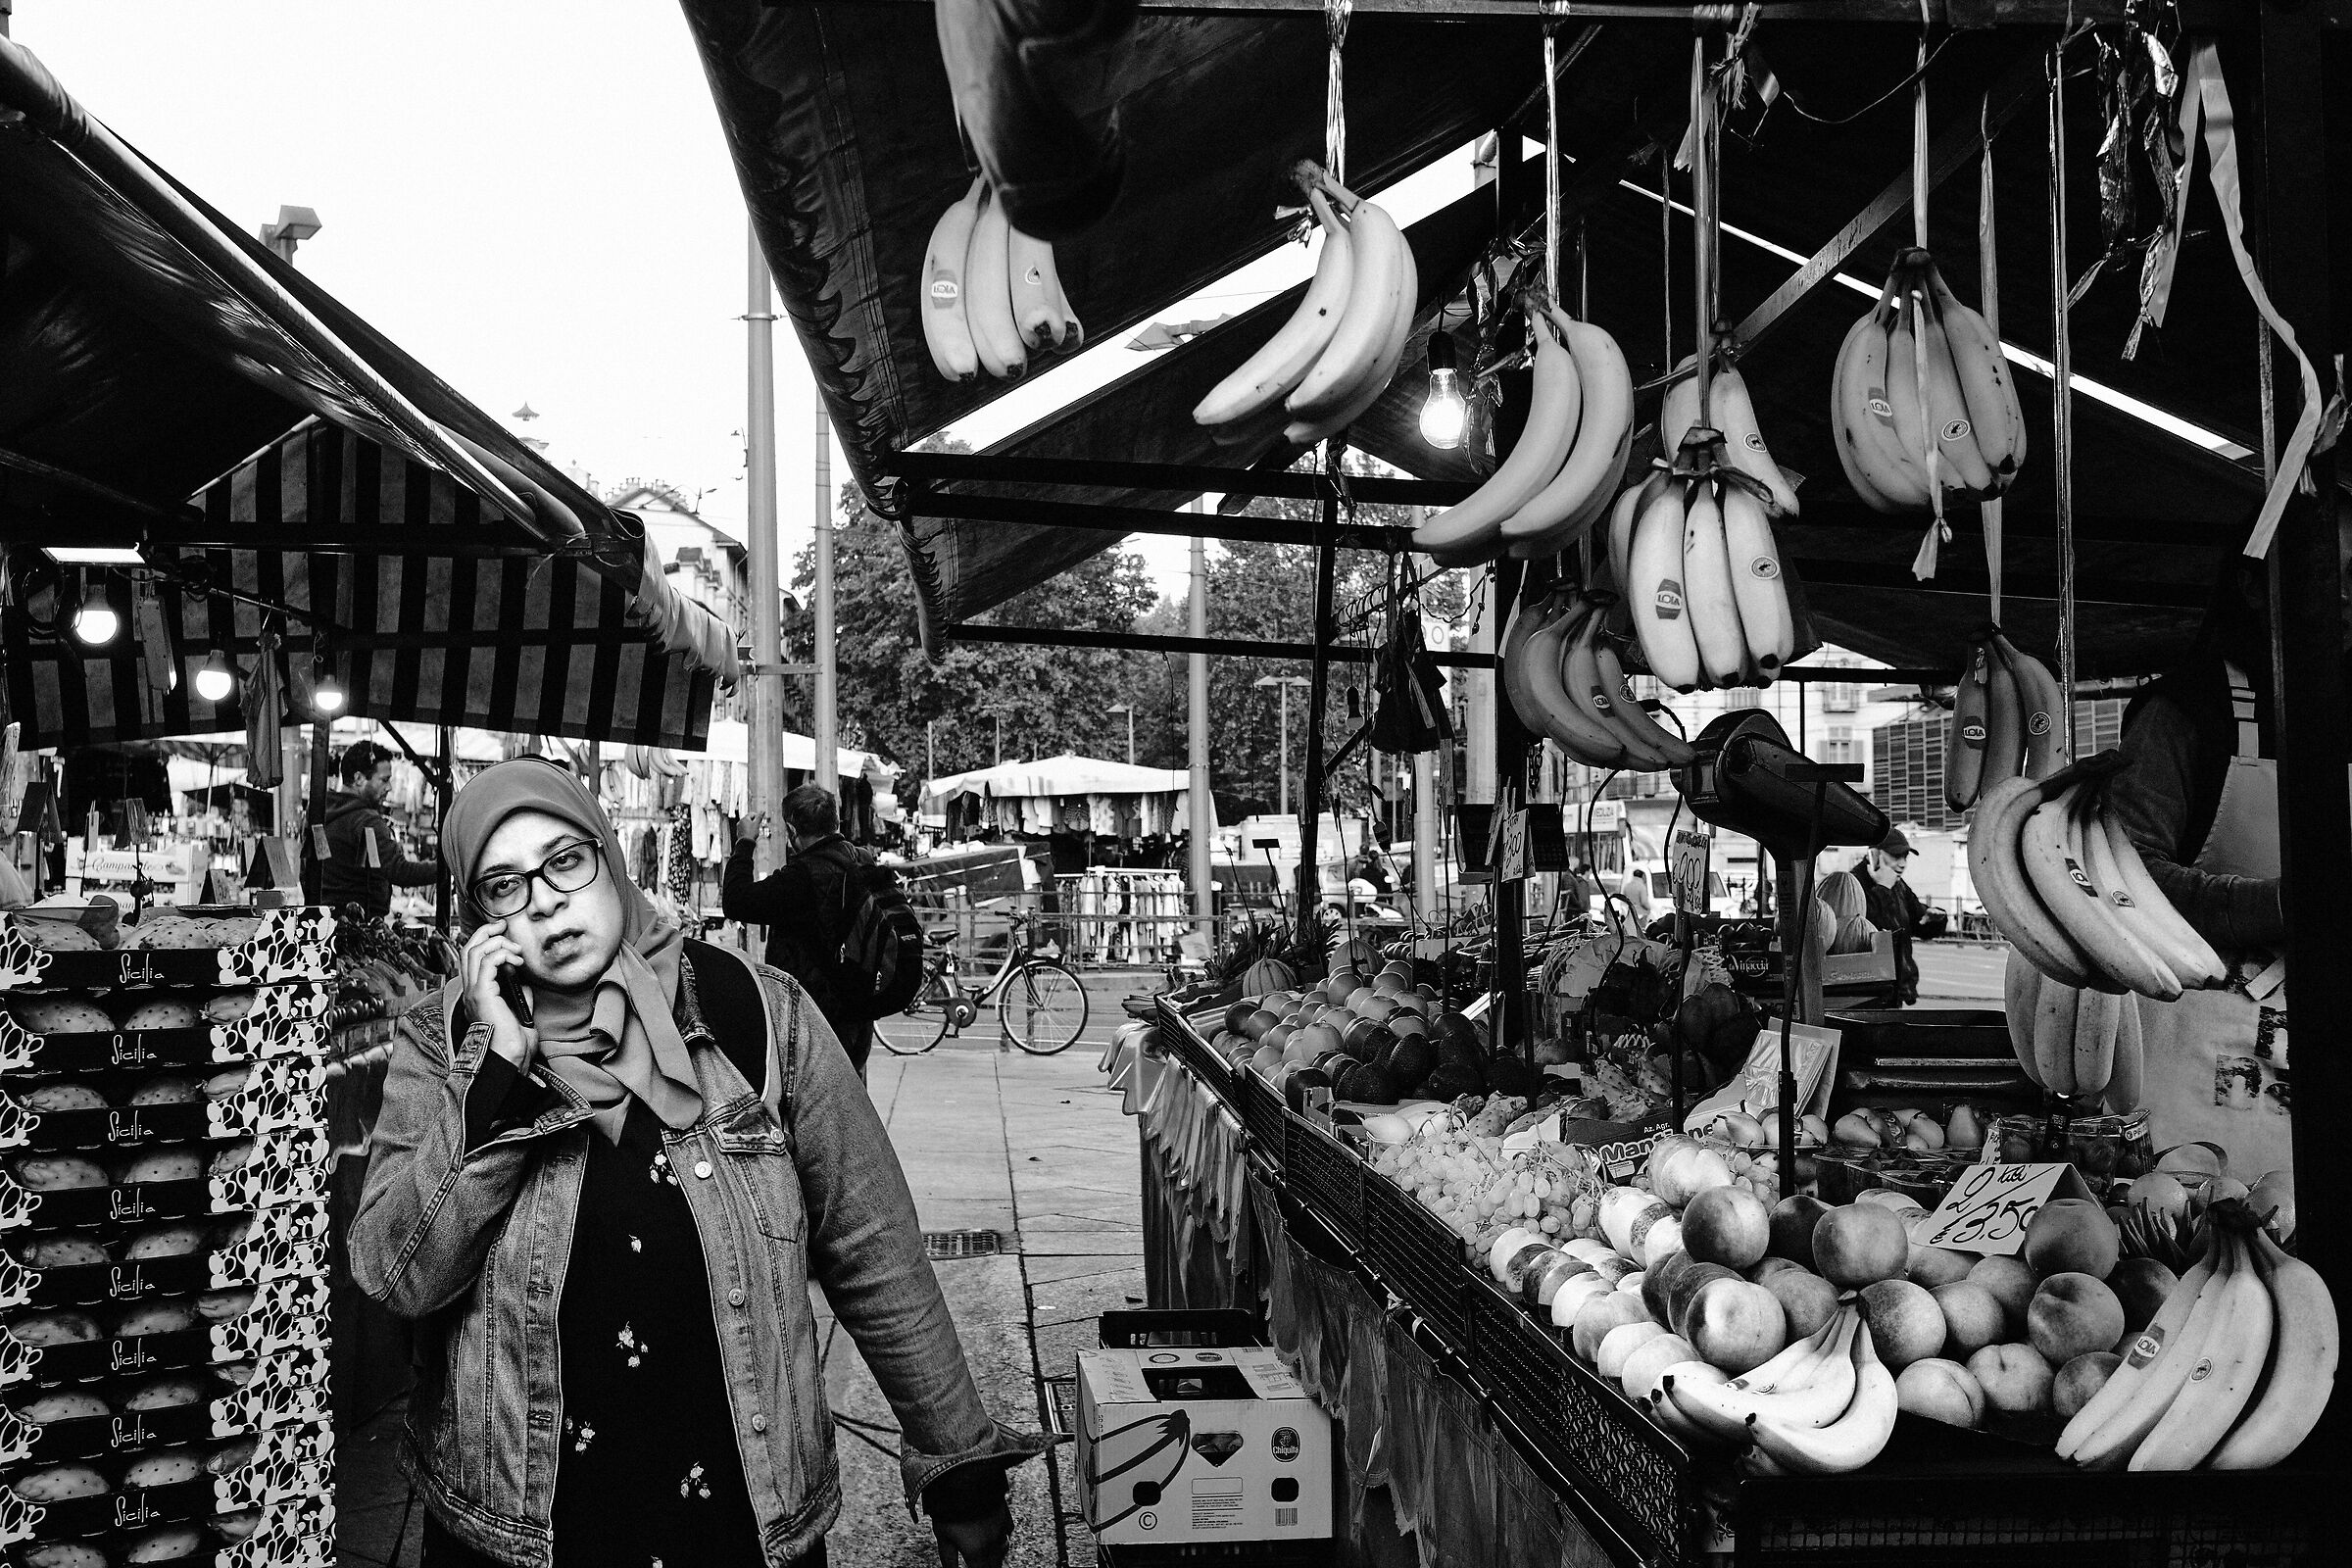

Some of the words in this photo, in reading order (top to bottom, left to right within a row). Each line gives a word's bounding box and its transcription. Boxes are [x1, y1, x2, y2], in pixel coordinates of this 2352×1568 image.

[120, 954, 164, 983] Sicilia
[112, 1034, 157, 1064] Sicilia
[108, 1109, 154, 1141] Sicilia
[110, 1188, 155, 1219] Sicilia
[110, 1265, 155, 1297] Sicilia
[112, 1338, 157, 1370] Sicilia
[111, 1415, 157, 1447] Sicilia
[115, 1494, 160, 1526] Sicilia
